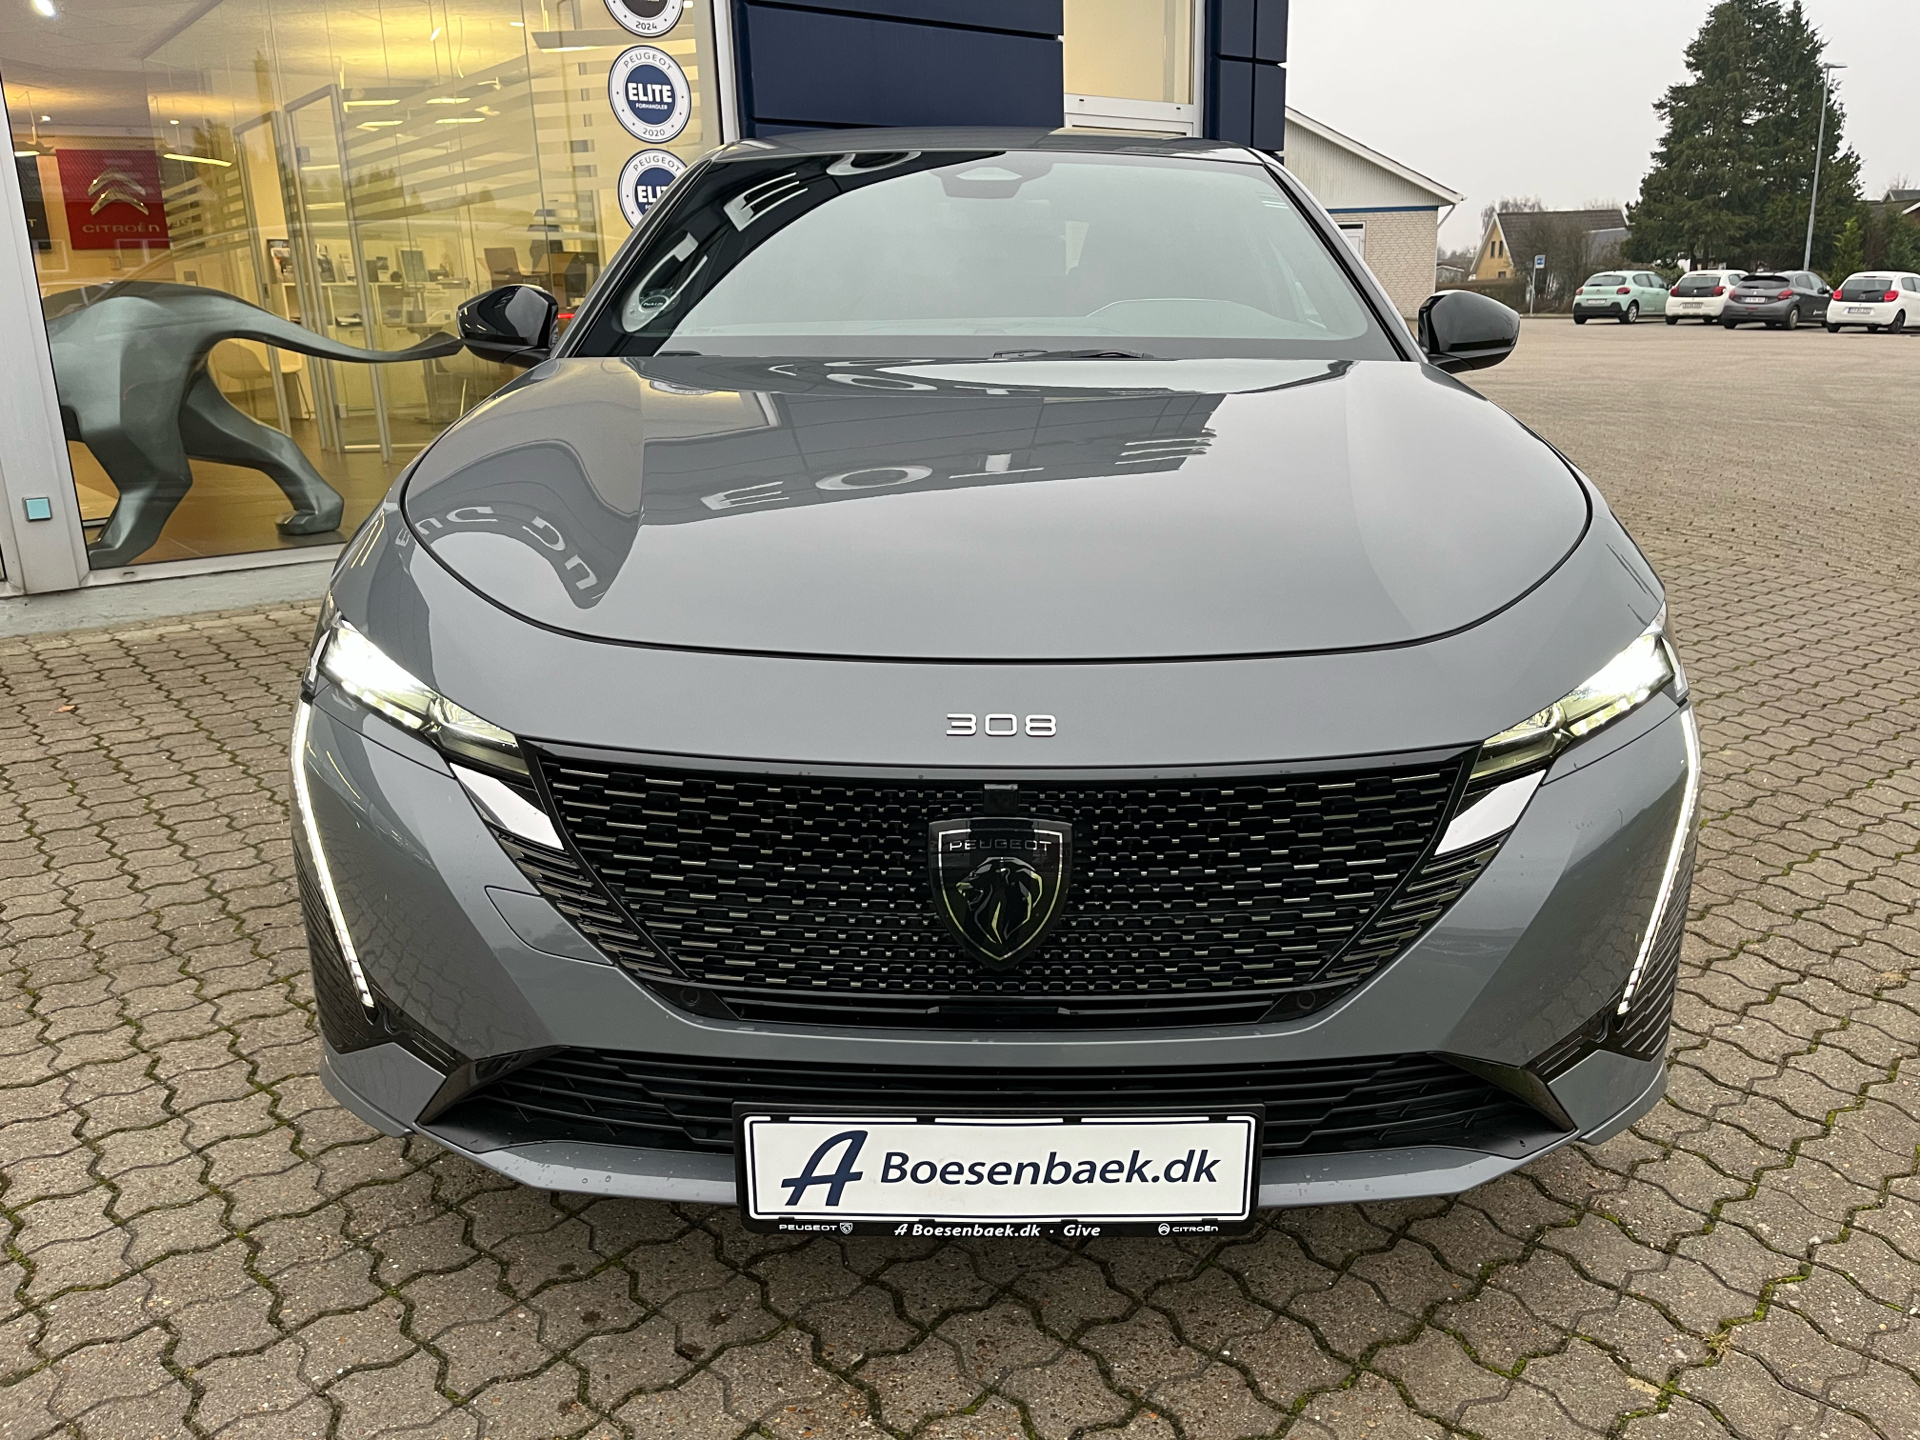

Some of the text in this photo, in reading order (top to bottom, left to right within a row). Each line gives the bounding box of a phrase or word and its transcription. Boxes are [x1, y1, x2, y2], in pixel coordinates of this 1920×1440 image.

[635, 21, 657, 30] 2024
[623, 52, 673, 71] PEUGEOT
[627, 83, 673, 102] ELITE
[642, 128, 666, 137] 2020
[633, 155, 681, 172] PEUGEOT
[946, 713, 1057, 737] 308
[950, 839, 1052, 851] PEUGEOT
[881, 1150, 1221, 1185] Boesenbaek.dk
[912, 1223, 1041, 1237] Boesenbaek.dk
[1063, 1224, 1100, 1237] Give
